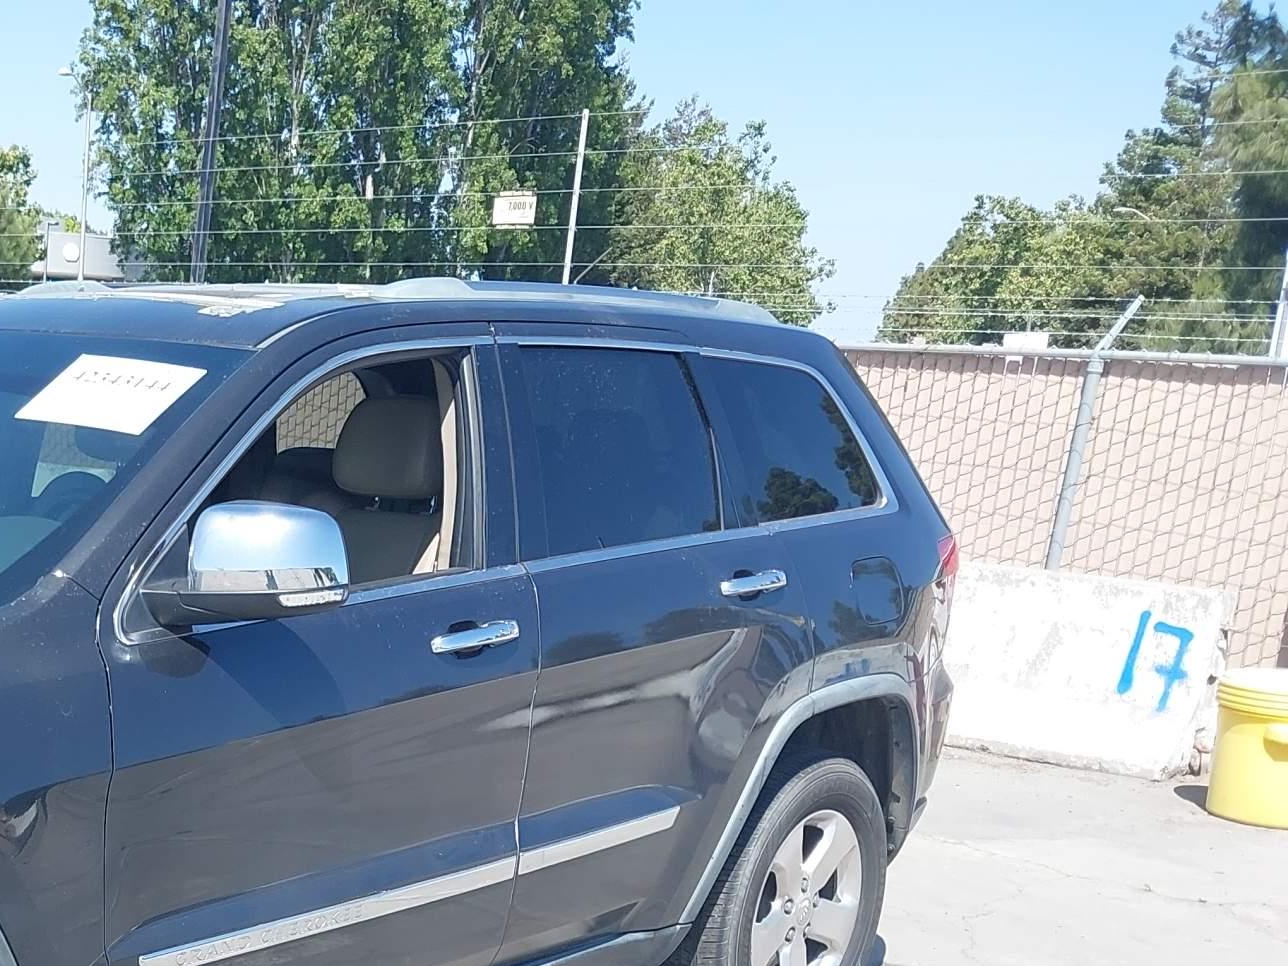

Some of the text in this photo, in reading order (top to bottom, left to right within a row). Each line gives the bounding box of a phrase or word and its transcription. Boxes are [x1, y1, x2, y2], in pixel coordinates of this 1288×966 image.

[1117, 610, 1194, 712] 17
[175, 903, 364, 966] GRAND CHEROKEE
